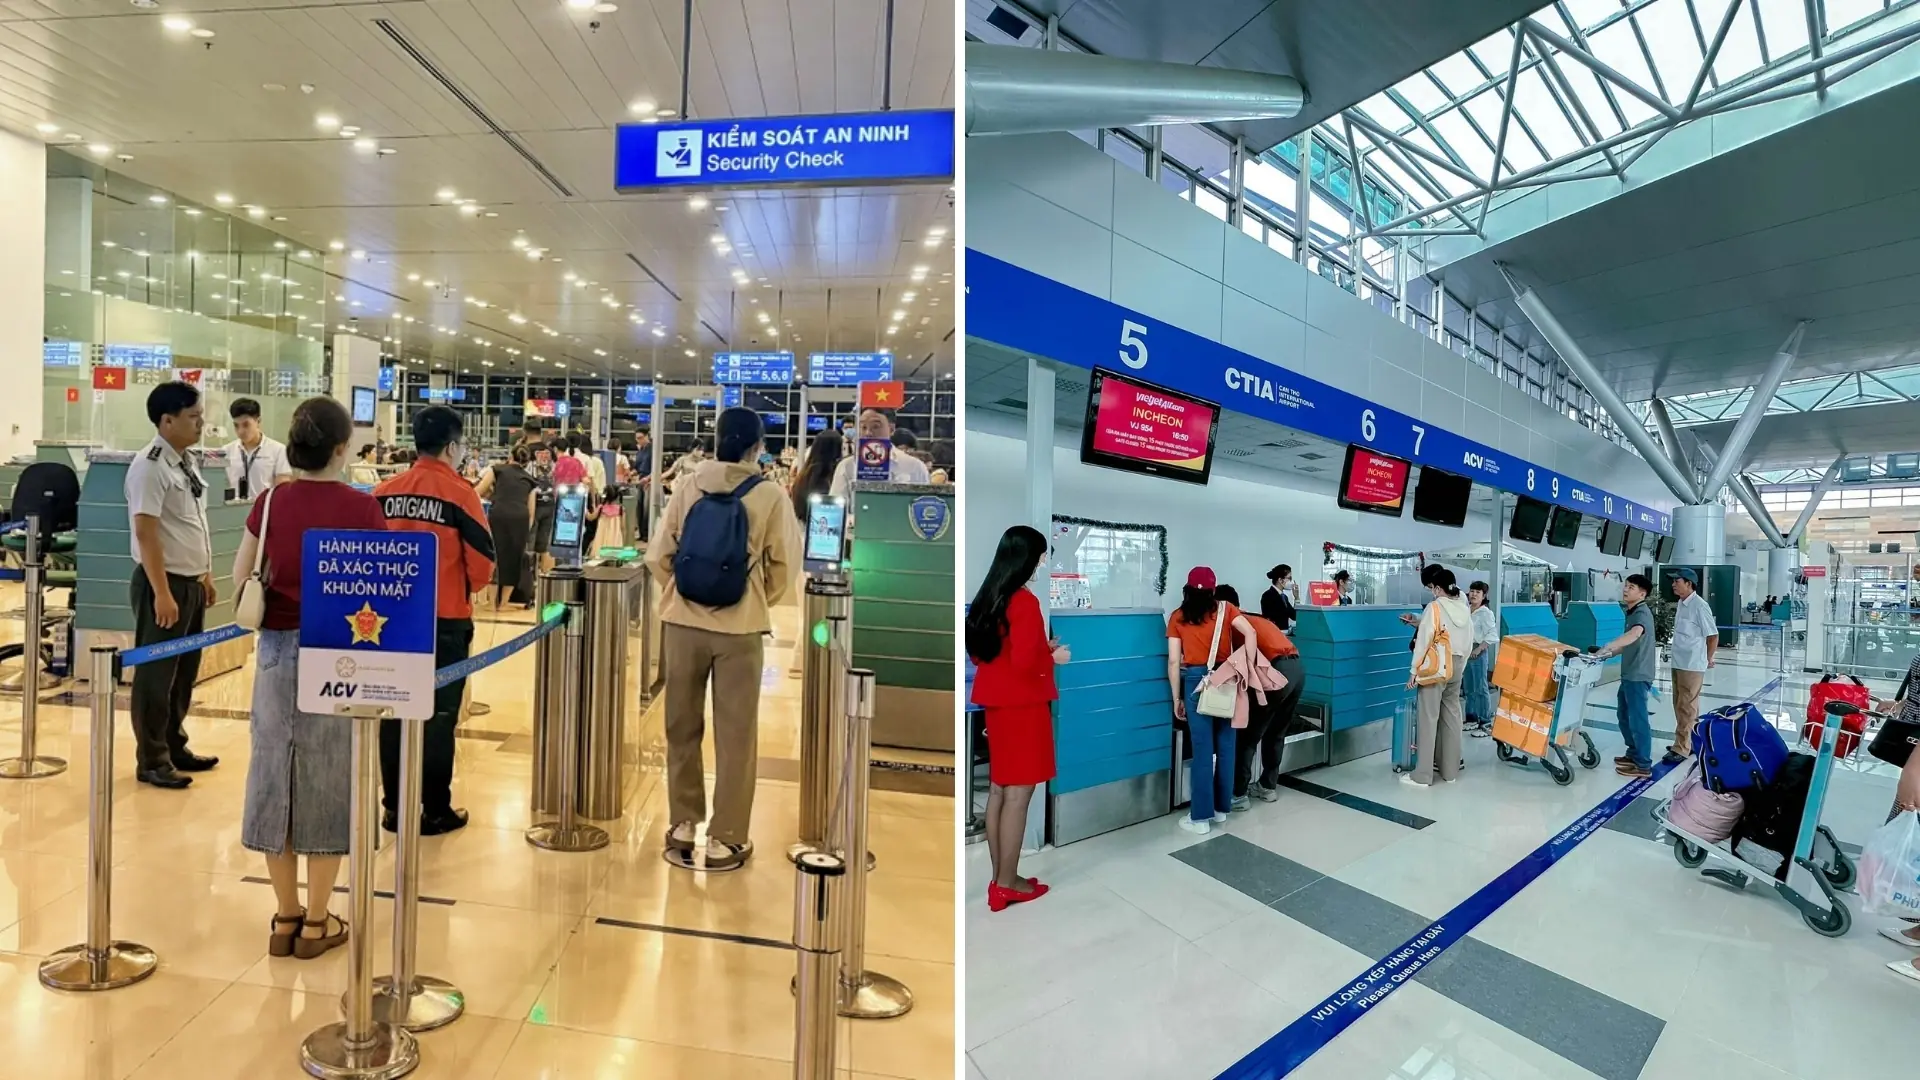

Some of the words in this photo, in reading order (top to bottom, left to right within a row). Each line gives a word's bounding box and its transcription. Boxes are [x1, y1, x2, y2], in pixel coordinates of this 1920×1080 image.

[707, 124, 757, 149] KIỂM
[762, 125, 818, 146] SOÁT
[823, 127, 851, 144] AN
[858, 125, 910, 143] NINH
[707, 152, 780, 173] Security
[785, 150, 844, 168] Check
[1118, 319, 1148, 370] 5
[1225, 367, 1274, 402] CTIA
[1278, 391, 1316, 409] INTERNATIONAL
[1278, 398, 1300, 410] AIRPORT
[1130, 421, 1140, 430] VJ
[1132, 406, 1184, 428] INCHEON
[1361, 409, 1376, 442] 6
[1412, 424, 1425, 456] 7
[1463, 451, 1484, 469] ACV
[1367, 468, 1392, 480] INCHEON
[1527, 468, 1535, 491] 8
[1552, 477, 1559, 499] 9
[384, 496, 446, 523] ORIGIANL
[1603, 495, 1613, 515] 10
[1625, 503, 1633, 520] 11
[1661, 515, 1668, 532] 12
[319, 537, 363, 554] HÀNH
[365, 539, 419, 556] KHÁCH
[318, 558, 340, 574] ĐÃ
[342, 559, 373, 575] XÁC
[376, 561, 419, 579] THỰC
[323, 579, 378, 596] KHUÔN
[380, 580, 412, 601] MẶT
[319, 681, 358, 699] ACV
[1311, 1003, 1338, 1021] VUI
[1334, 981, 1368, 1007] LÒNG
[1364, 966, 1387, 984] XẾP
[1385, 948, 1415, 969] HÀNG
[1411, 936, 1430, 952] TẠI
[1425, 924, 1446, 940] ĐÂY
[1357, 982, 1394, 1009] Please
[1391, 960, 1422, 983] Queue
[1418, 945, 1441, 962] Here
